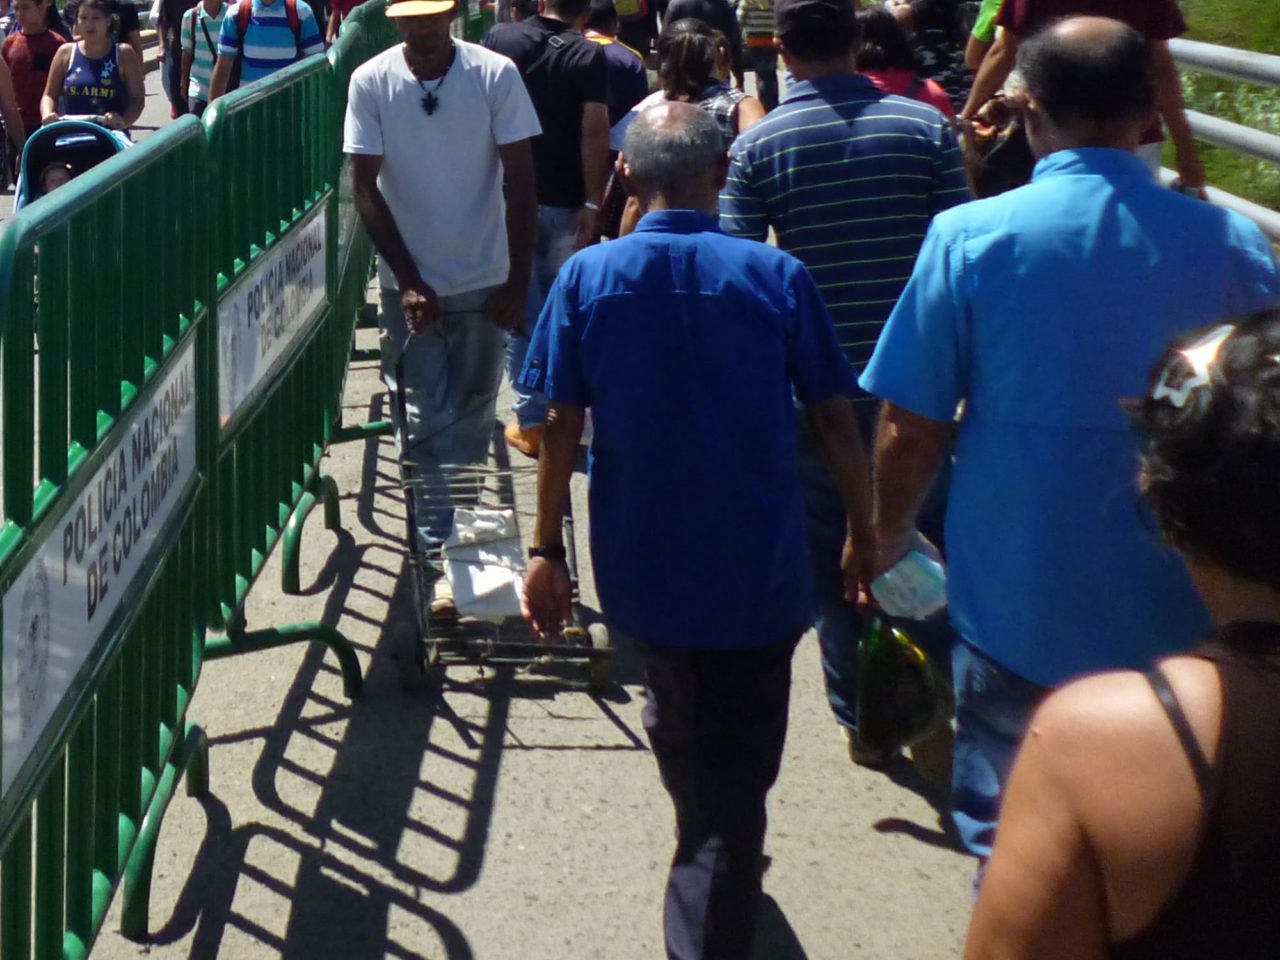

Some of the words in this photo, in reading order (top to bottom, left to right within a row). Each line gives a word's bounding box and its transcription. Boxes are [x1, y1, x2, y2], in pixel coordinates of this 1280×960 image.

[246, 260, 285, 329] POLICIA
[285, 222, 322, 286] NACIONAL
[63, 447, 128, 587] POLICIA
[131, 364, 192, 482] NACIONAL
[86, 541, 109, 622] DE
[112, 436, 179, 577] COLOMBIA
